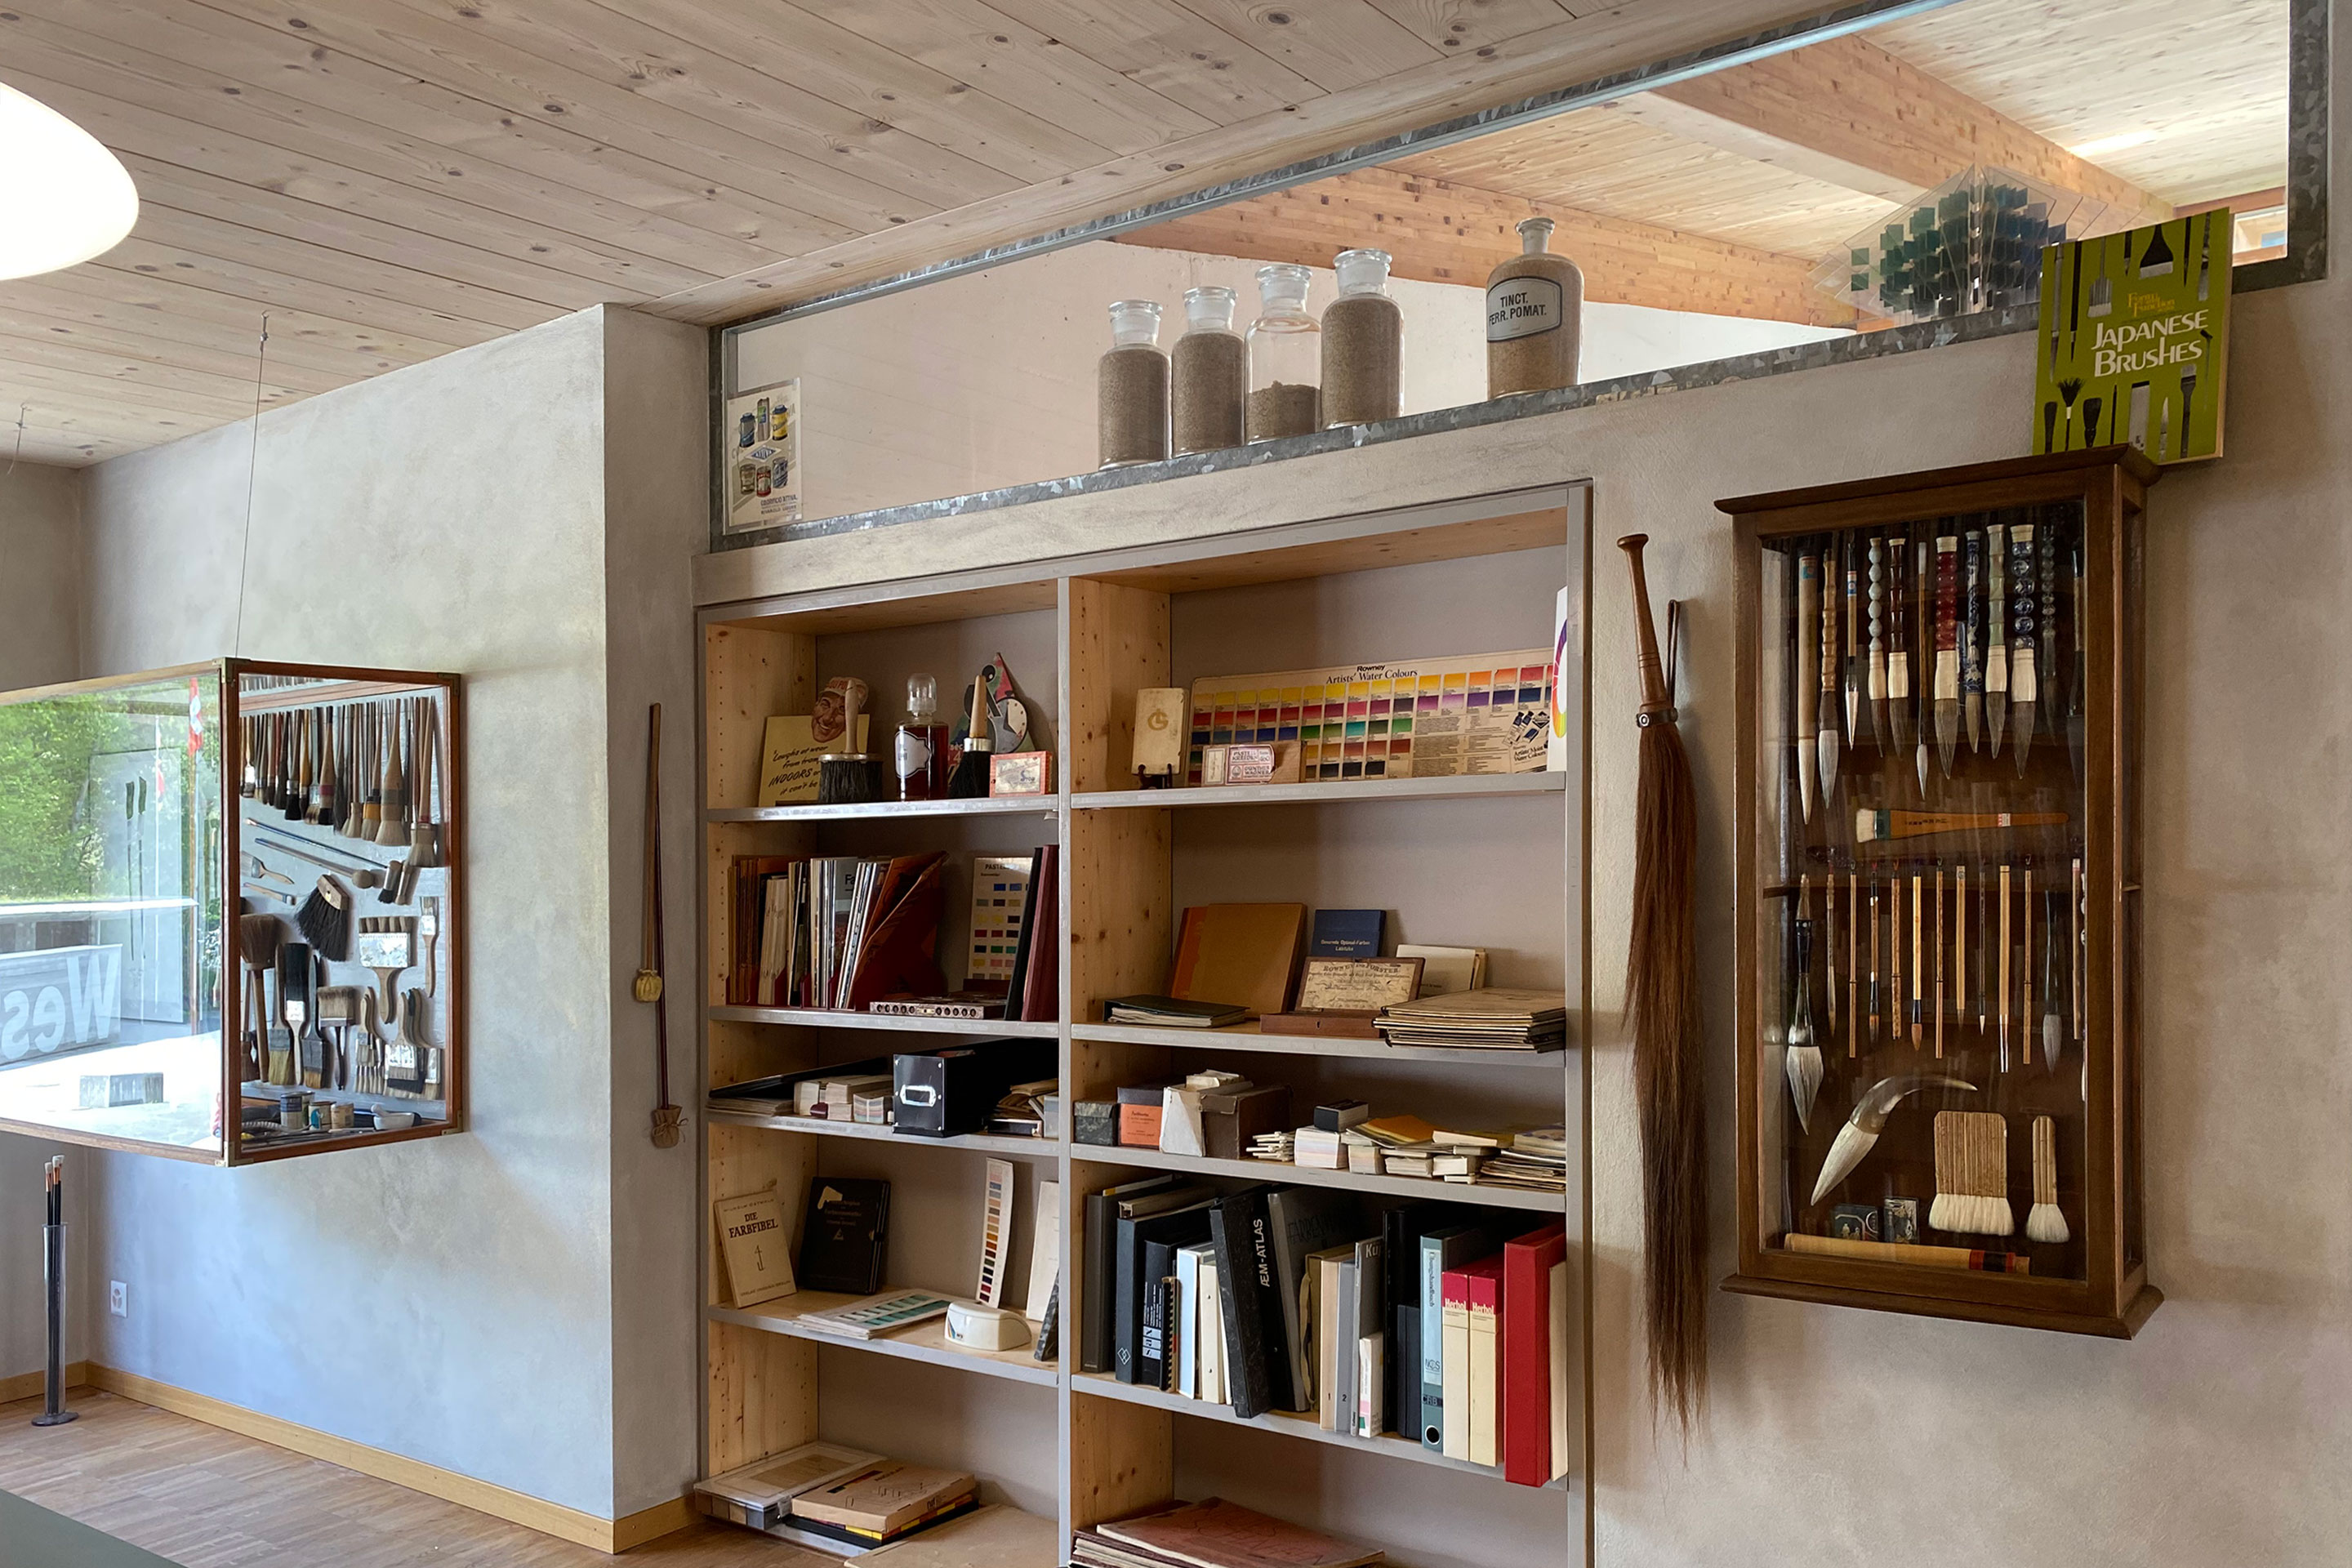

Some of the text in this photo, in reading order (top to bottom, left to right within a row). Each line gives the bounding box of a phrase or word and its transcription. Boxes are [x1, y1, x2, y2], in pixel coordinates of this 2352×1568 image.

[1500, 292, 1529, 307] TINCT.
[1510, 305, 1547, 319] POMAT.
[2091, 309, 2208, 352] JAPANESE
[2094, 336, 2203, 377] BRUSHES
[1358, 672, 1383, 681] Water
[1384, 669, 1418, 679] Colours
[782, 760, 800, 769] from
[768, 768, 813, 787] INDOORS
[845, 874, 855, 884] Fa
[745, 1212, 758, 1222] DIE
[728, 1218, 778, 1238] FARBFIBEL
[1365, 1243, 1381, 1258] Ku
[1445, 1298, 1467, 1310] Herbol
[1472, 1302, 1494, 1313] Herbol
[1342, 1393, 1347, 1401] 2
